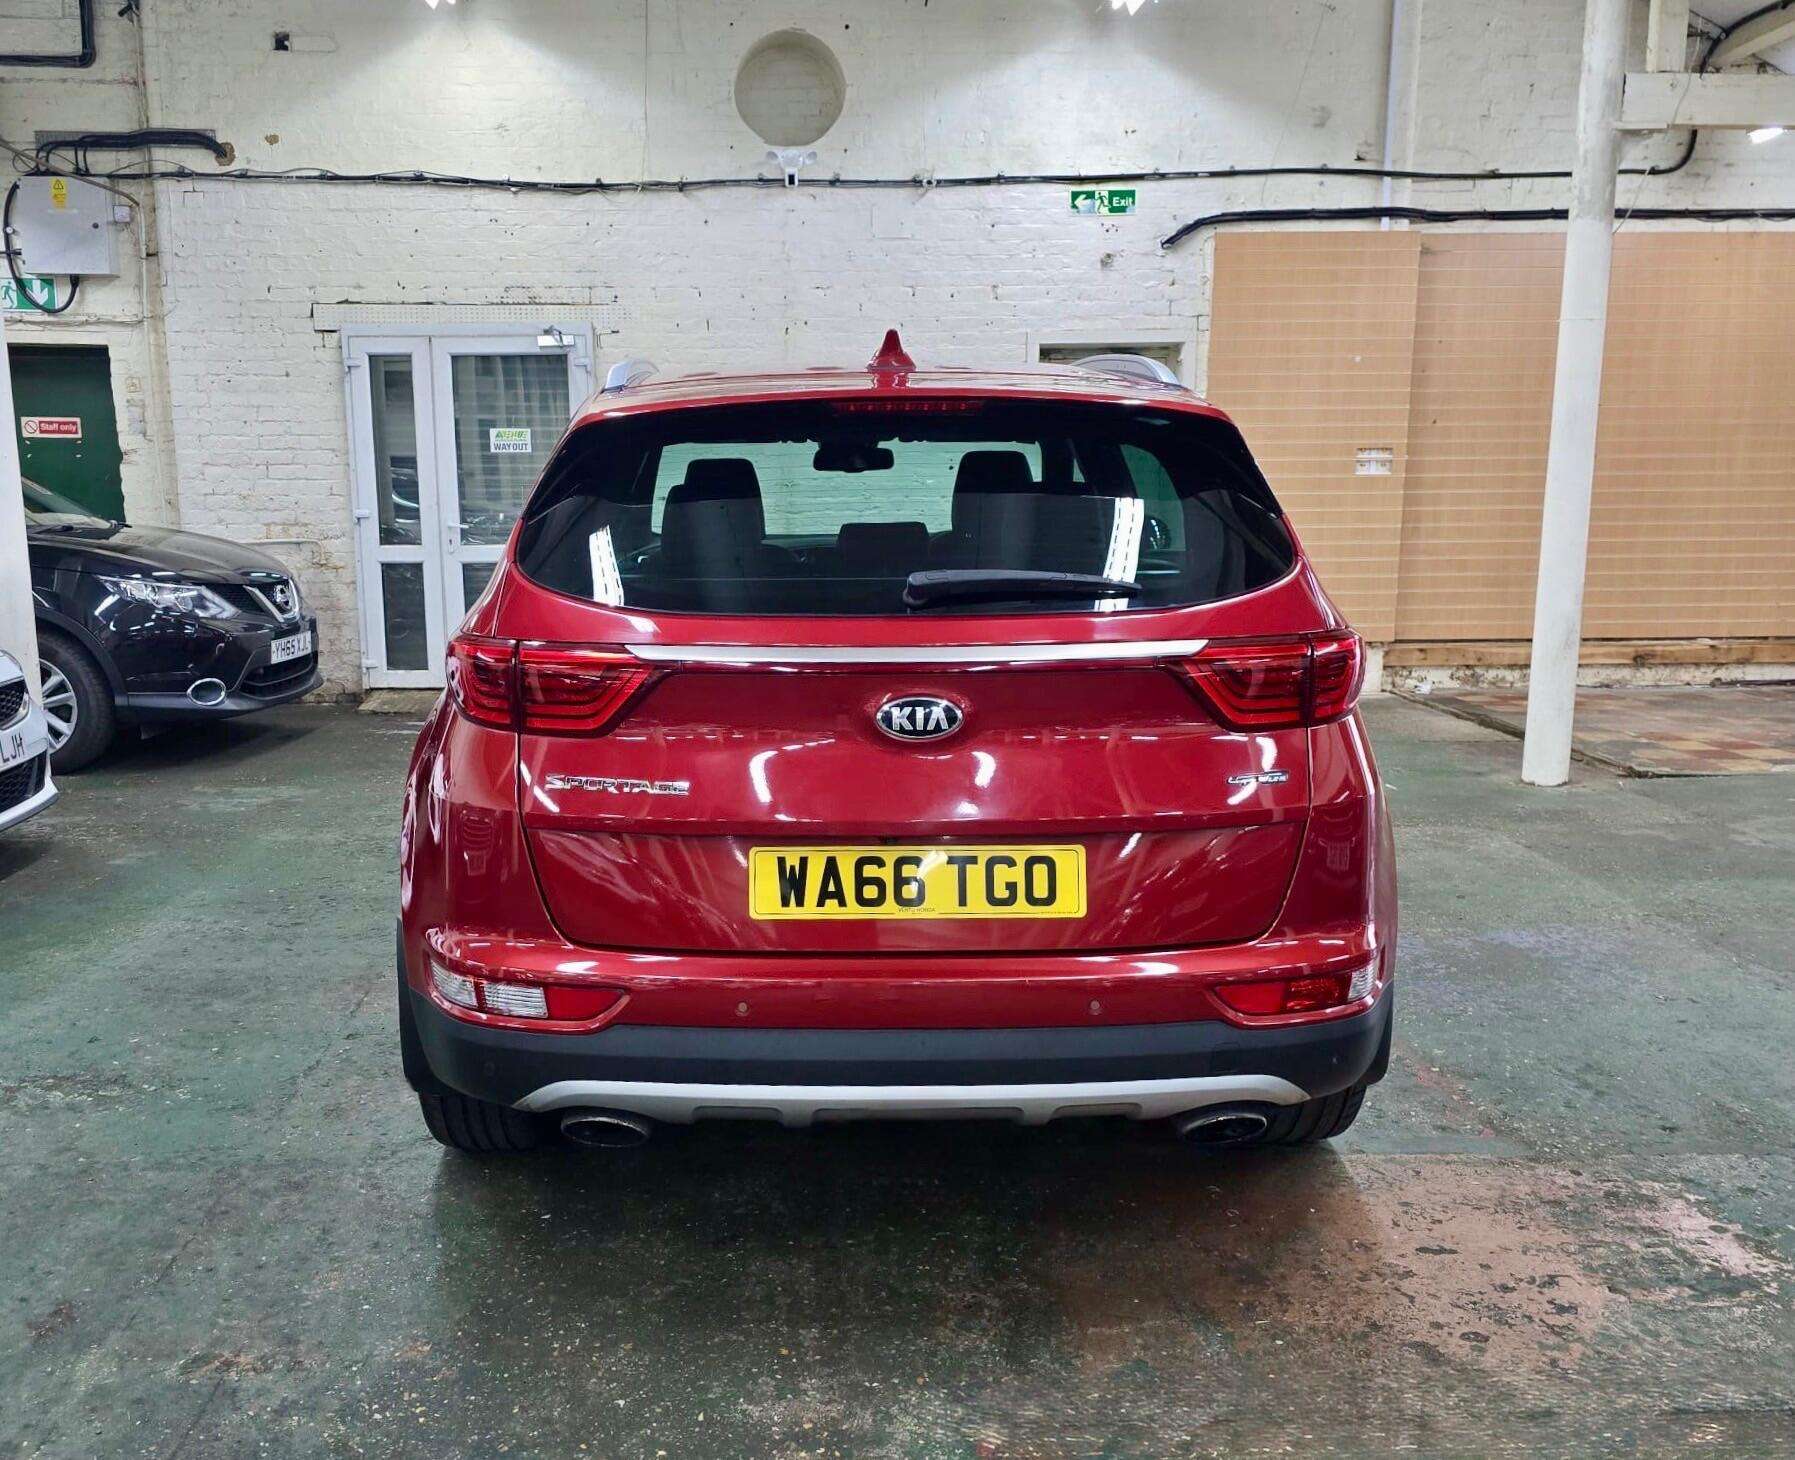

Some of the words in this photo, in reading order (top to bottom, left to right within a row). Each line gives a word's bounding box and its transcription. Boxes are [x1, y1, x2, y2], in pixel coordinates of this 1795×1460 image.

[1112, 197, 1133, 207] Exit
[40, 422, 59, 431] Staff
[60, 424, 77, 433] only
[493, 442, 511, 451] WAY
[512, 442, 528, 451] OUT
[275, 639, 296, 659] YH65
[891, 706, 949, 731] KIA
[545, 774, 690, 796] SPORTAGE
[777, 855, 926, 908] WA66
[946, 855, 1057, 907] TGO
